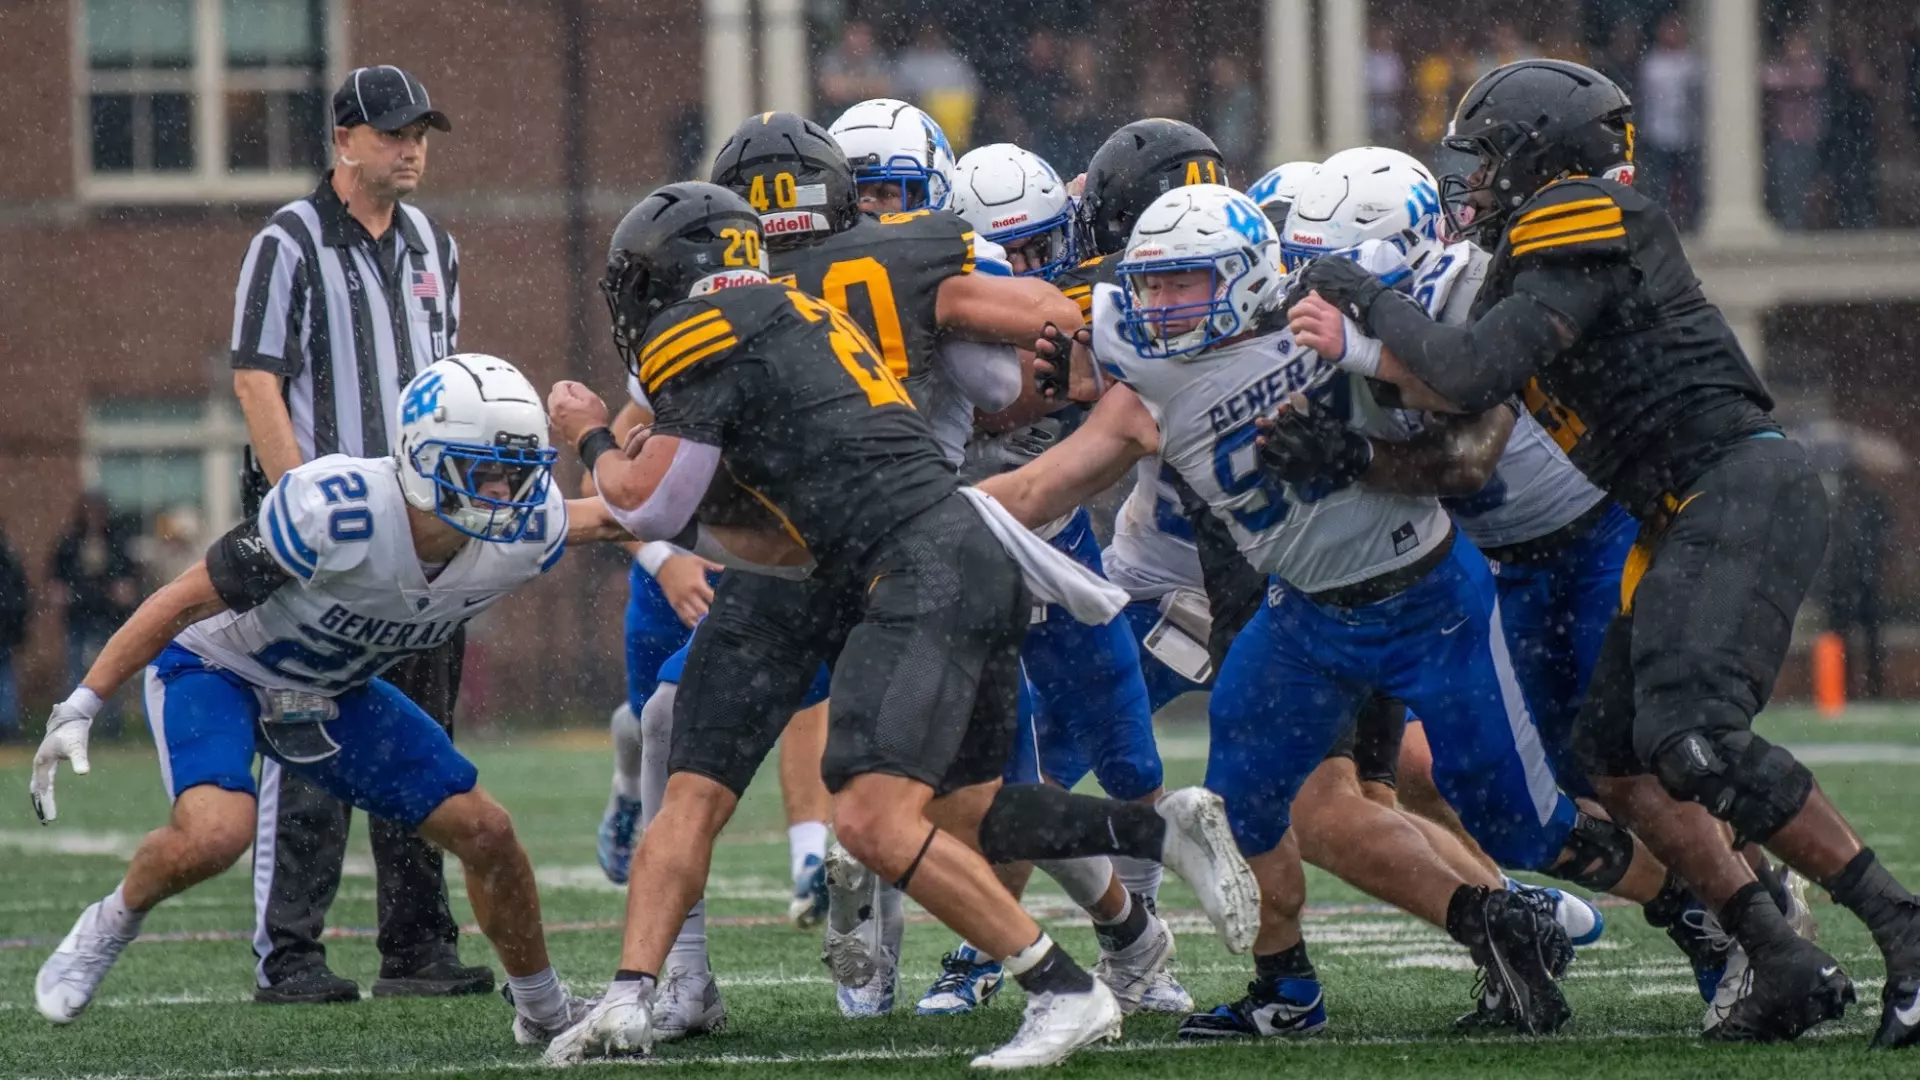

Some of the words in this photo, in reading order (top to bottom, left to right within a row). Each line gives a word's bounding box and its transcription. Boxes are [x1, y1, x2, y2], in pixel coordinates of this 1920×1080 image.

[749, 172, 797, 211] 40
[764, 214, 811, 234] ddell
[992, 214, 1028, 229] Riddell
[720, 228, 760, 267] 20
[1293, 234, 1323, 245] Riddell
[317, 470, 374, 543] 20
